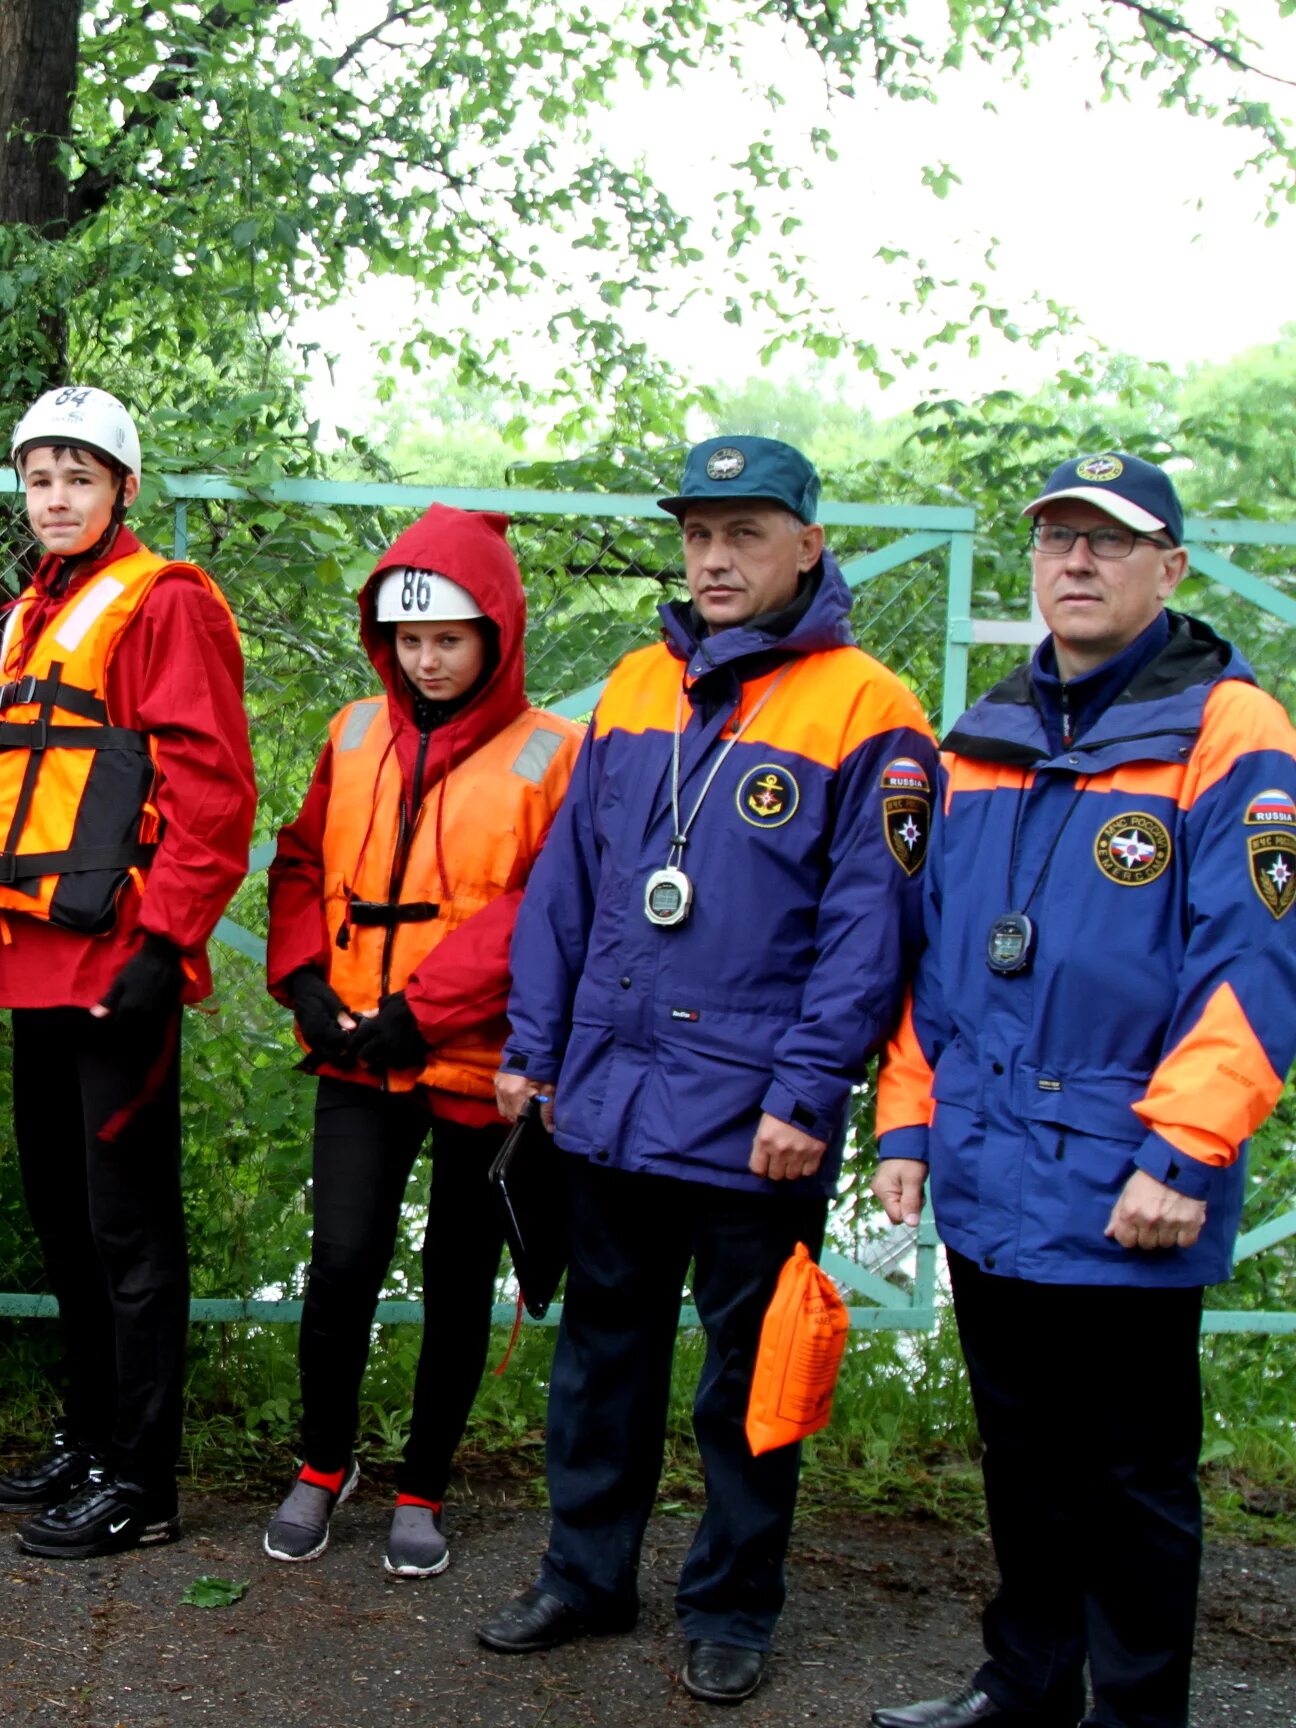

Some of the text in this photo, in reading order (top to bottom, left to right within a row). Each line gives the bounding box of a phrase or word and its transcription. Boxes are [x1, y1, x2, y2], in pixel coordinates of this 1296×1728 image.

[55, 388, 92, 408] 84
[401, 566, 432, 612] 86
[890, 778, 923, 787] RUSSIA
[1256, 812, 1292, 821] RUSSIA
[1105, 817, 1167, 848] МЧС РОССИИ
[1098, 849, 1163, 880] EMERCOM
